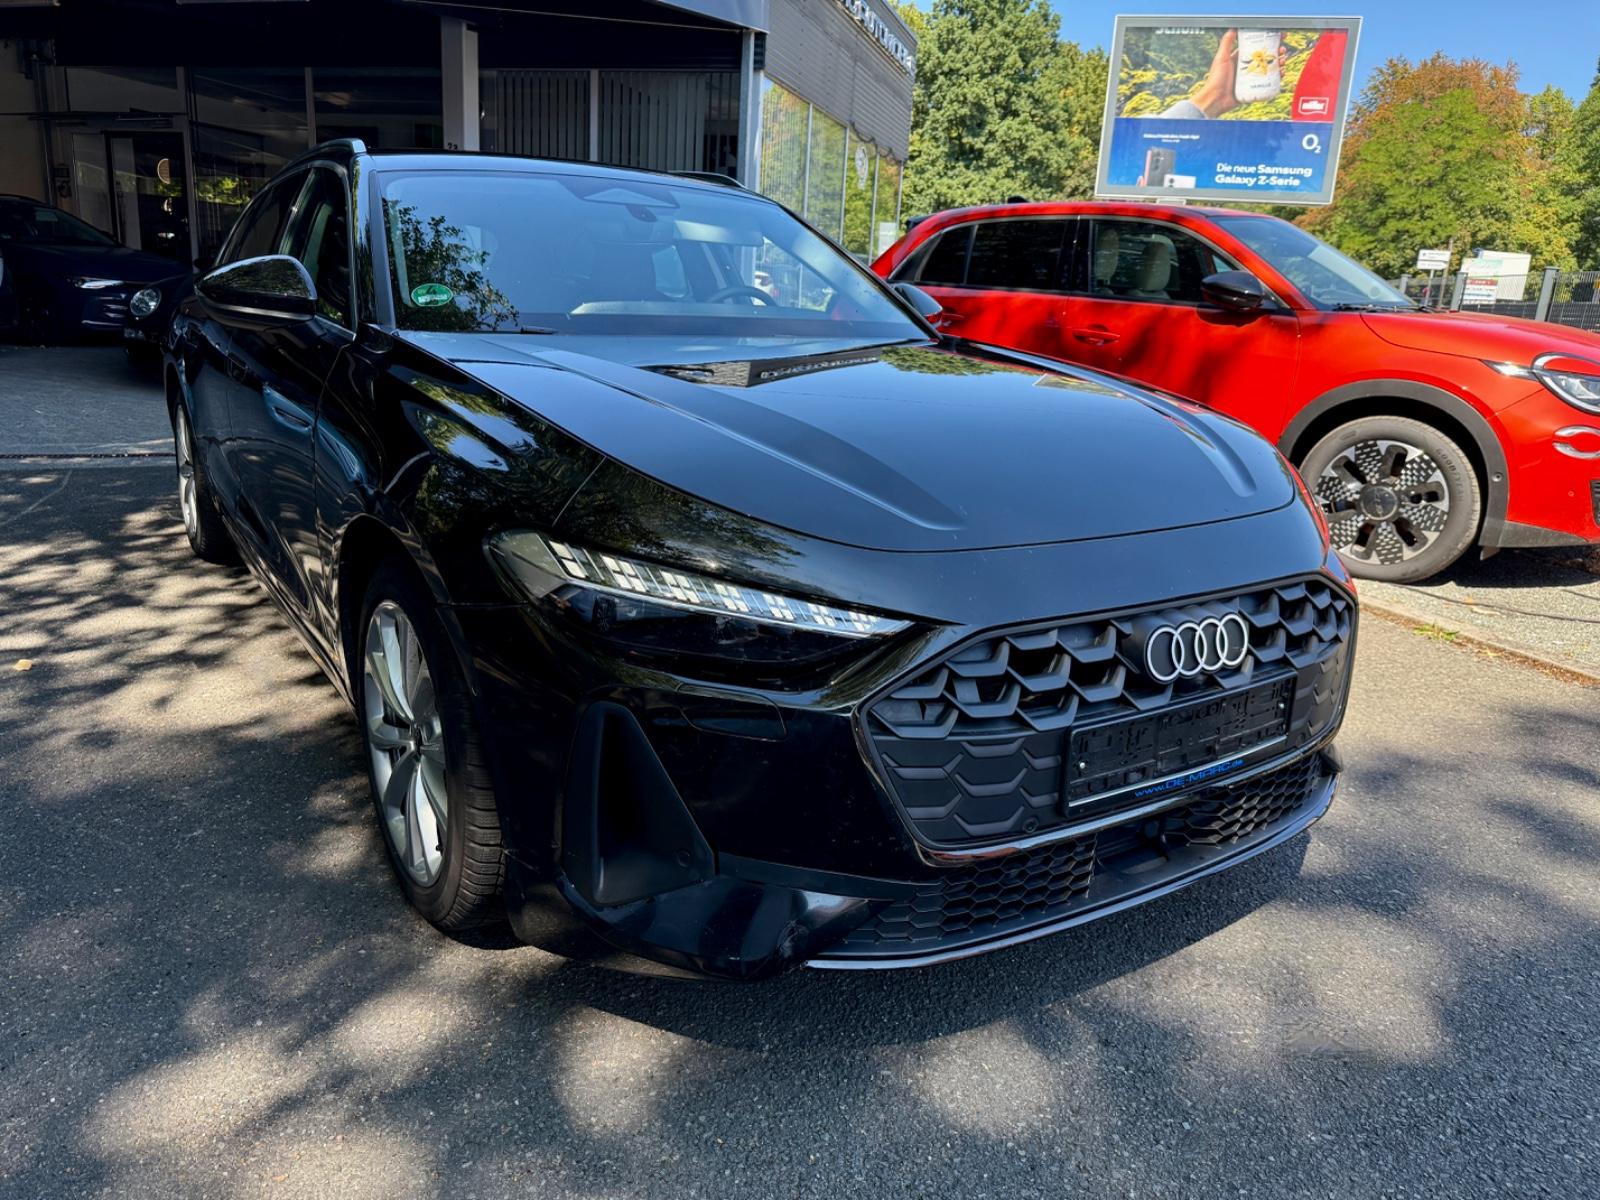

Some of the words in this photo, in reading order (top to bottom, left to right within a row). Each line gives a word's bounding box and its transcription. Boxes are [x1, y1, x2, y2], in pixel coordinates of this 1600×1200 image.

[1216, 163, 1232, 173] Die
[1233, 164, 1256, 174] neue
[1257, 164, 1313, 178] Samsung
[1215, 174, 1257, 187] Galaxy
[1257, 175, 1301, 187] Z-Serie
